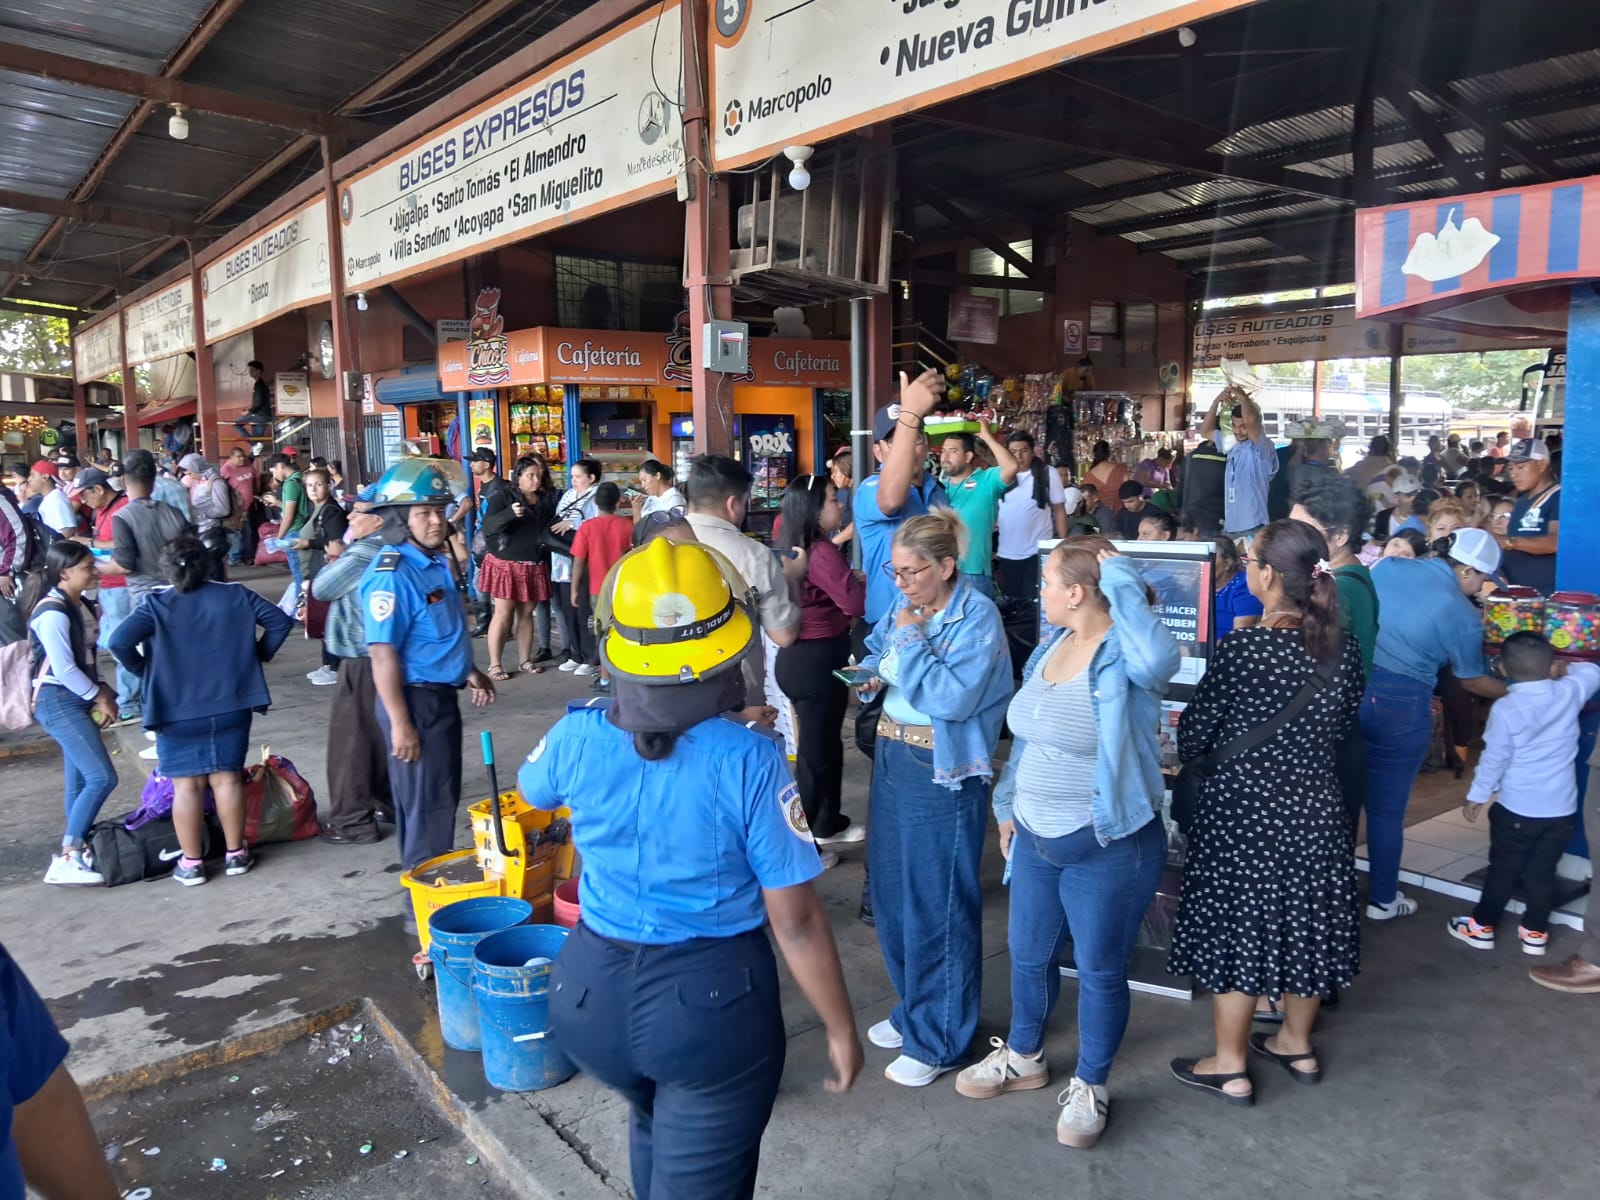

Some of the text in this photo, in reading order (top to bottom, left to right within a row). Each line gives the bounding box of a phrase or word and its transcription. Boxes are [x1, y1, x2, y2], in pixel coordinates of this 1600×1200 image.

[723, 0, 740, 24] 5
[896, 16, 995, 77] Nueva
[748, 74, 832, 122] Marcopolo
[400, 69, 586, 191] BUSES EXPRESOS
[393, 134, 586, 234] Juigalpa Santo Tomás El Almendro
[394, 166, 603, 260] Villa Sandino Acoyapa San Miguelito
[226, 220, 299, 279] BUSES RUTEADOS
[355, 251, 381, 270] Marcopolo
[1195, 314, 1335, 337] USES RUTEADOS
[556, 341, 641, 372] Cafetería
[1227, 339, 1271, 350] Terrabona
[1277, 334, 1327, 347] Esquipulas
[773, 350, 841, 377] Cafetería
[1152, 605, 1197, 616] UE HACER
